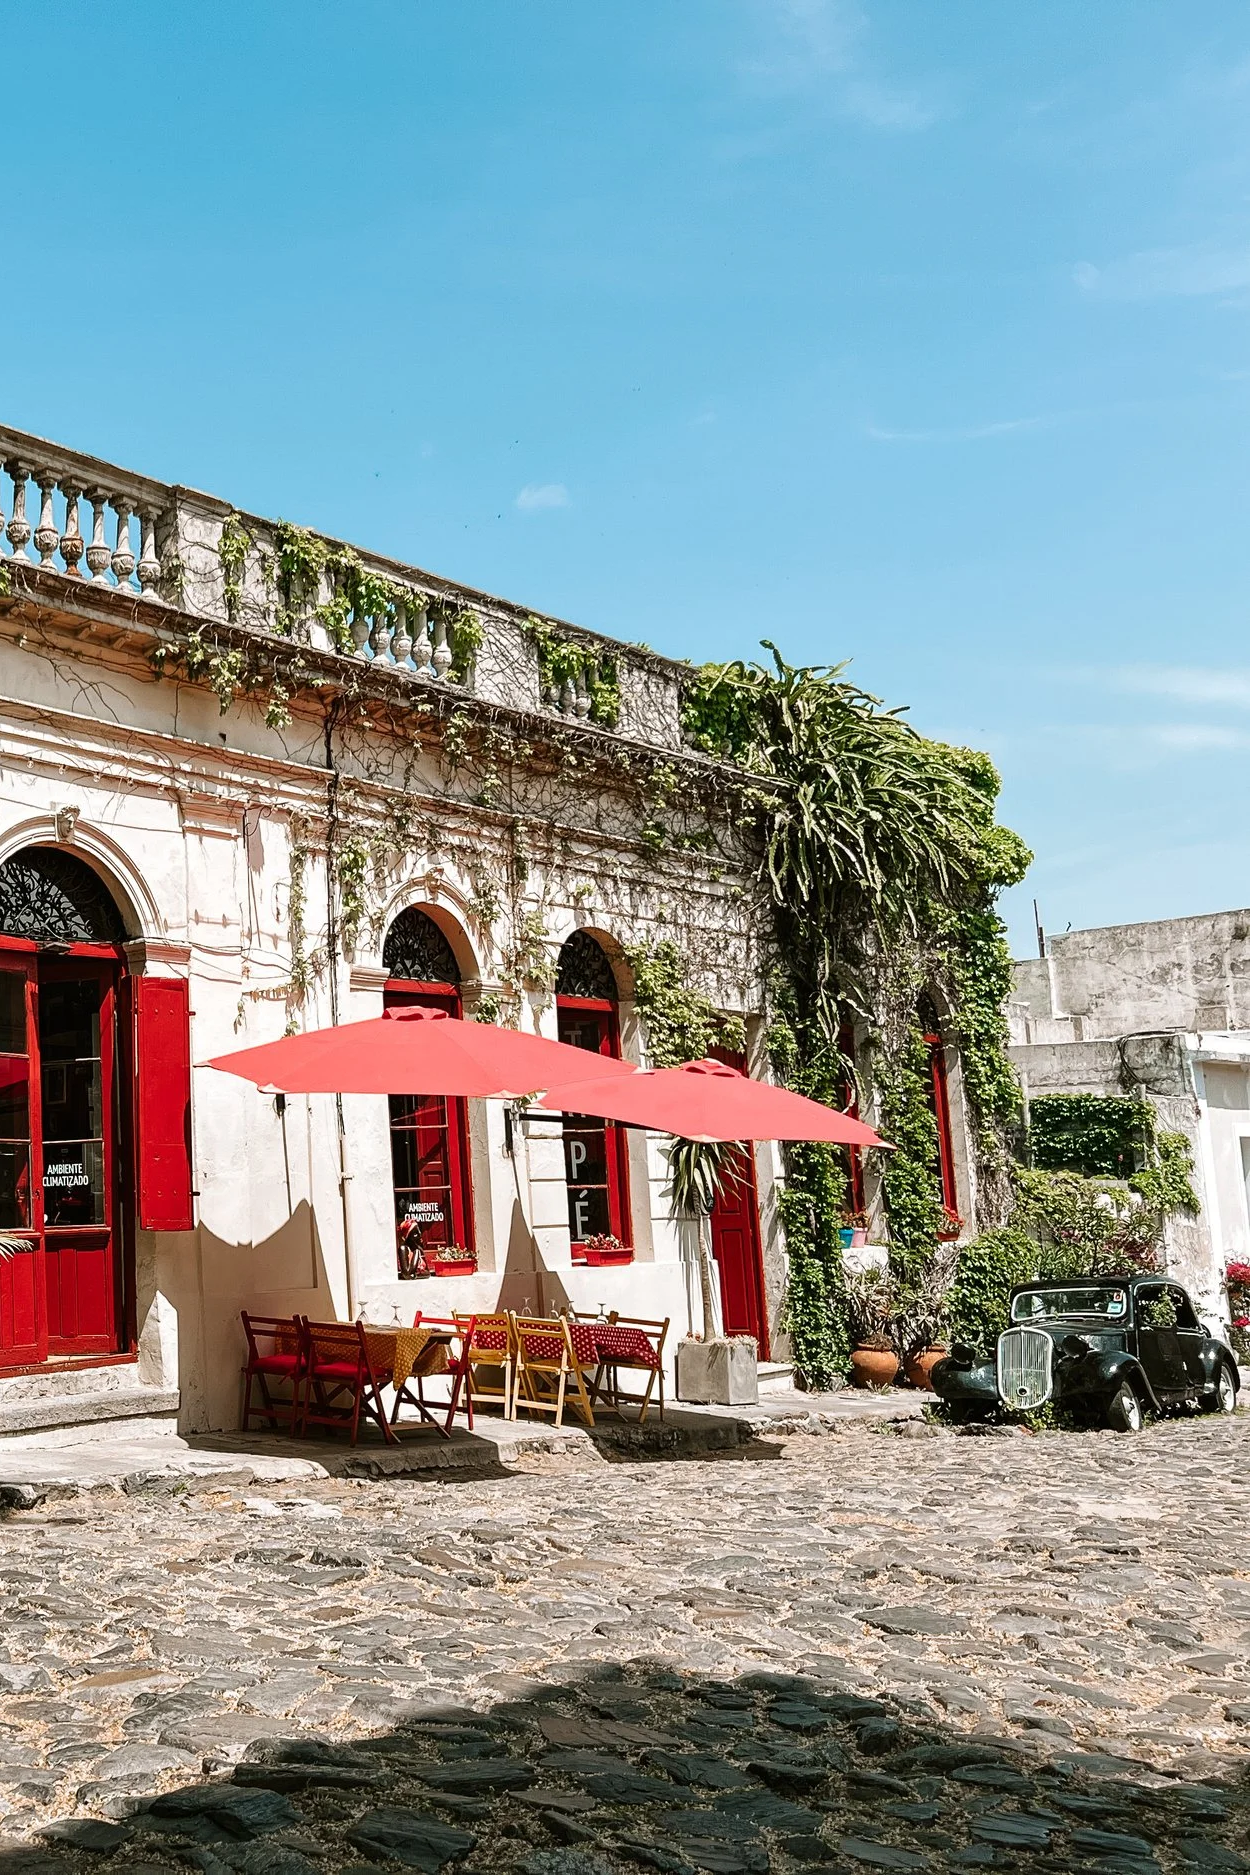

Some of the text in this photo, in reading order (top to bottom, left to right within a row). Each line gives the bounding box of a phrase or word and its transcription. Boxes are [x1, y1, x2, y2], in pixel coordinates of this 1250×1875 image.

[47, 1163, 83, 1174] AMBIENTE
[42, 1175, 88, 1187] CLIMATIZADO
[408, 1202, 438, 1212] AMBIENTE
